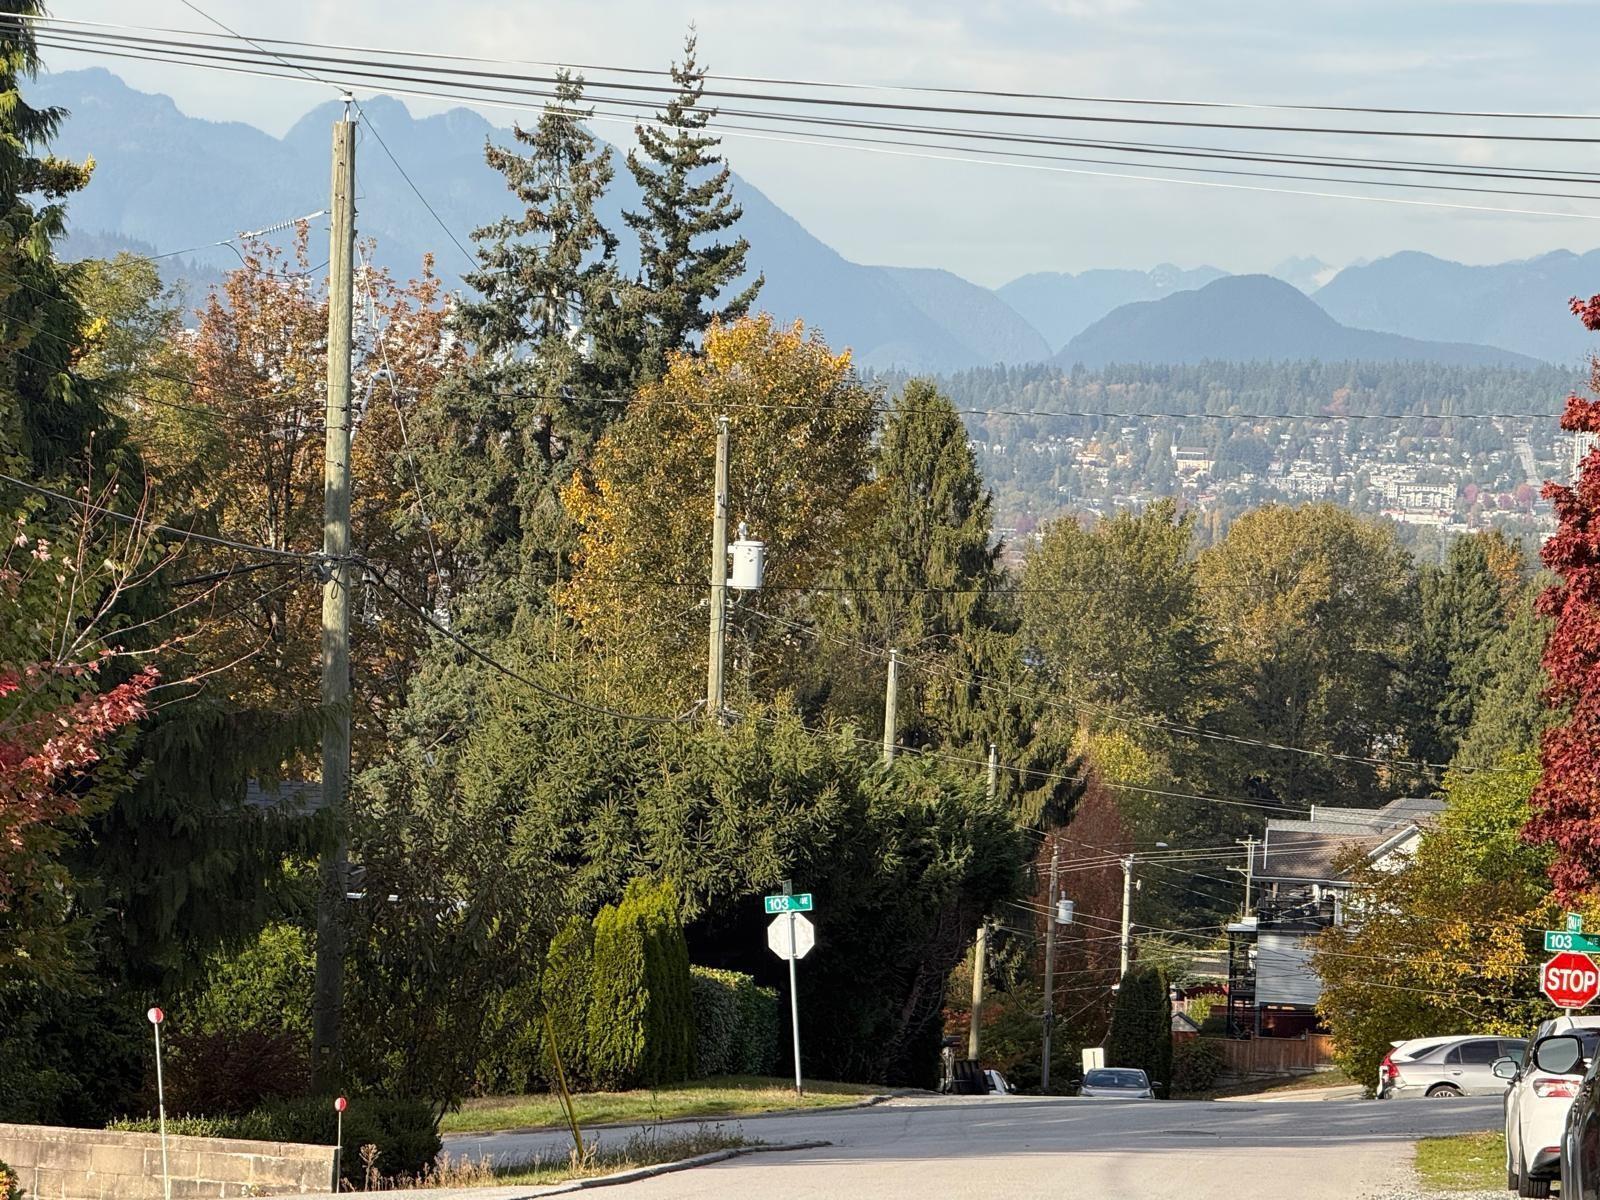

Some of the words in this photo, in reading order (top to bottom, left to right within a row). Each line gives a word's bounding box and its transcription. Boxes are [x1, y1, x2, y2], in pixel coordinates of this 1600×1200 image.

[769, 898, 789, 910] 103
[1550, 934, 1572, 949] 103
[1547, 967, 1596, 993] STOP
